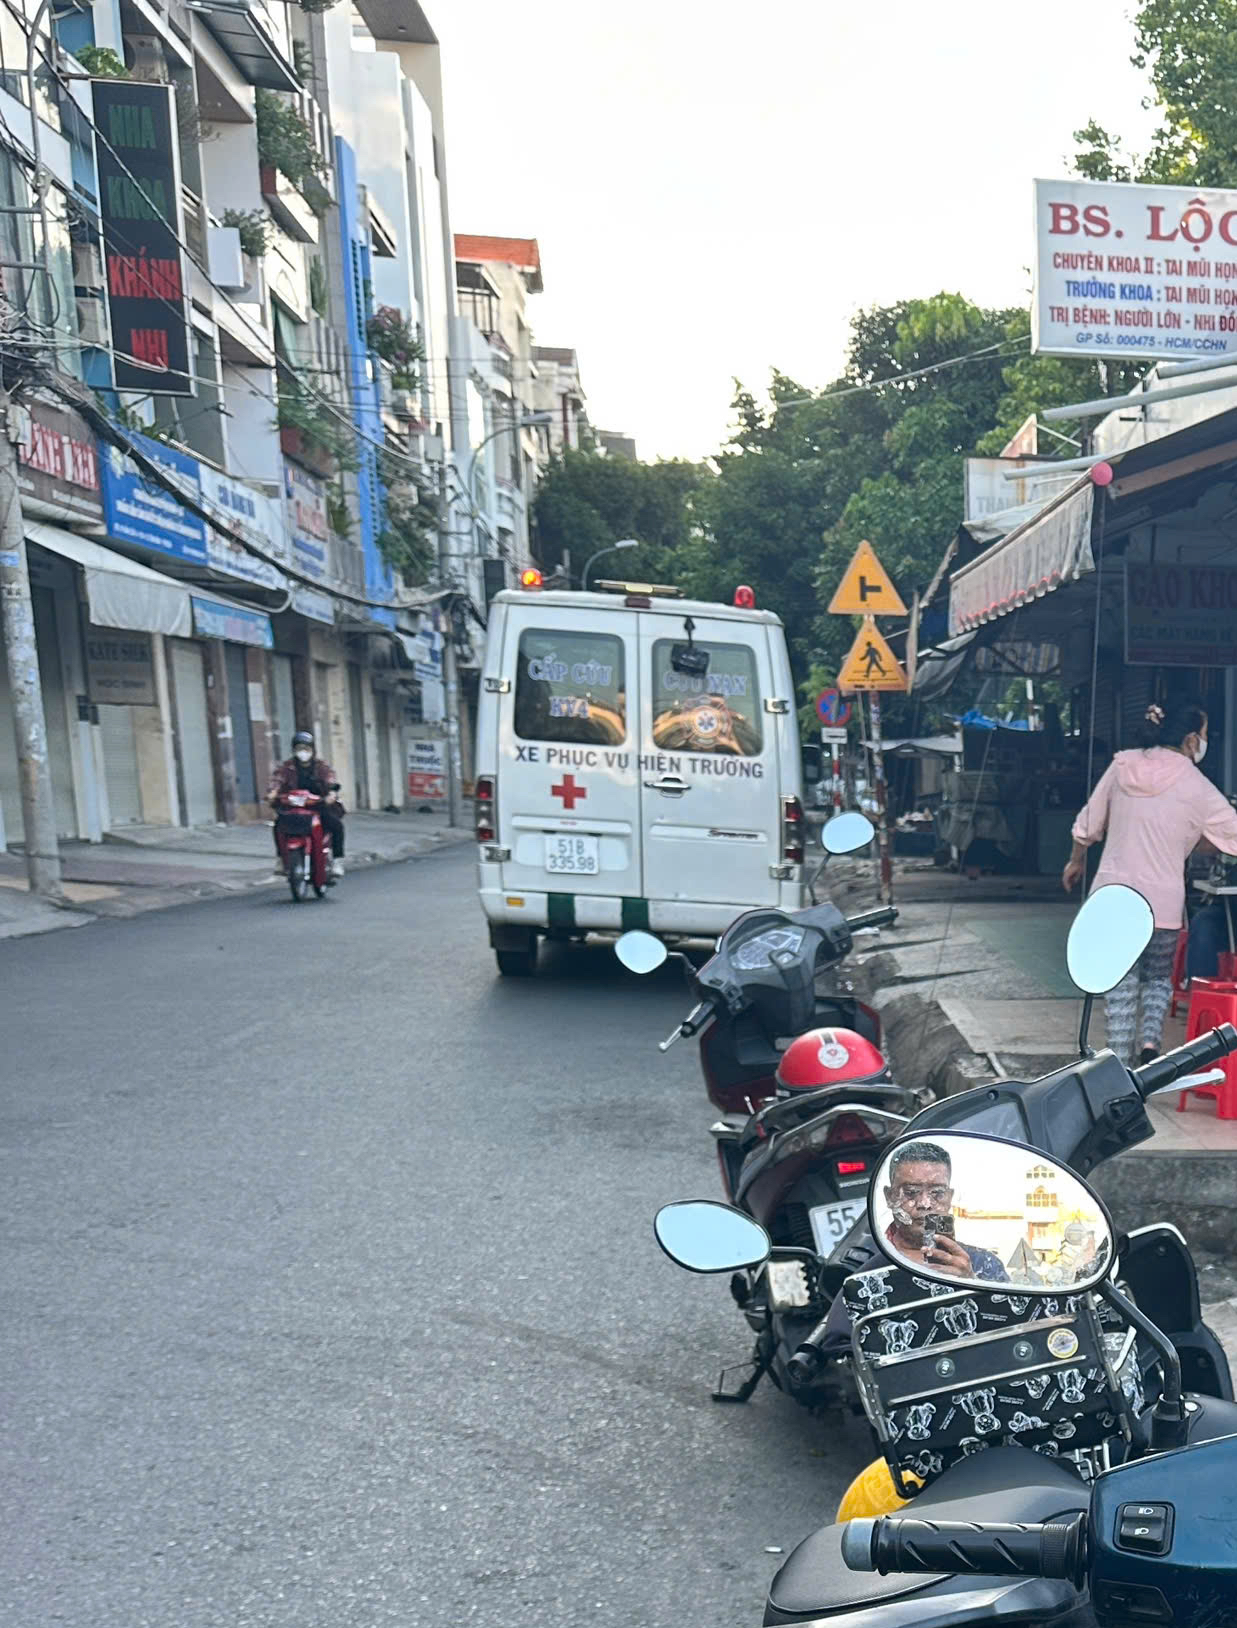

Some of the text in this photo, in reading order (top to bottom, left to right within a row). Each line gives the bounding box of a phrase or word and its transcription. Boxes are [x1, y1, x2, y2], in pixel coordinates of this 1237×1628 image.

[1048, 202, 1124, 239] BS.
[108, 246, 181, 298] KHÁNH
[1053, 252, 1104, 272] CHUYÊN
[1107, 256, 1141, 274] KHOA
[1164, 259, 1183, 276] TAI
[1187, 257, 1210, 278] MŨI
[1065, 275, 1116, 299] TRƯỞNG
[1120, 283, 1153, 301] KHOA
[1164, 286, 1183, 303] TAI
[1187, 284, 1210, 304] MŨI
[1049, 306, 1069, 327] TRỊ
[1114, 306, 1153, 328] NGƯỜI
[1157, 309, 1181, 329] LỚN
[1194, 314, 1216, 331] NHI
[1076, 332, 1093, 344] GP
[1164, 337, 1228, 351] HCM/CCHN
[515, 745, 764, 778] XE PHỤC VỤ HIỆN TRƯỜNG
[558, 838, 585, 856] 51B
